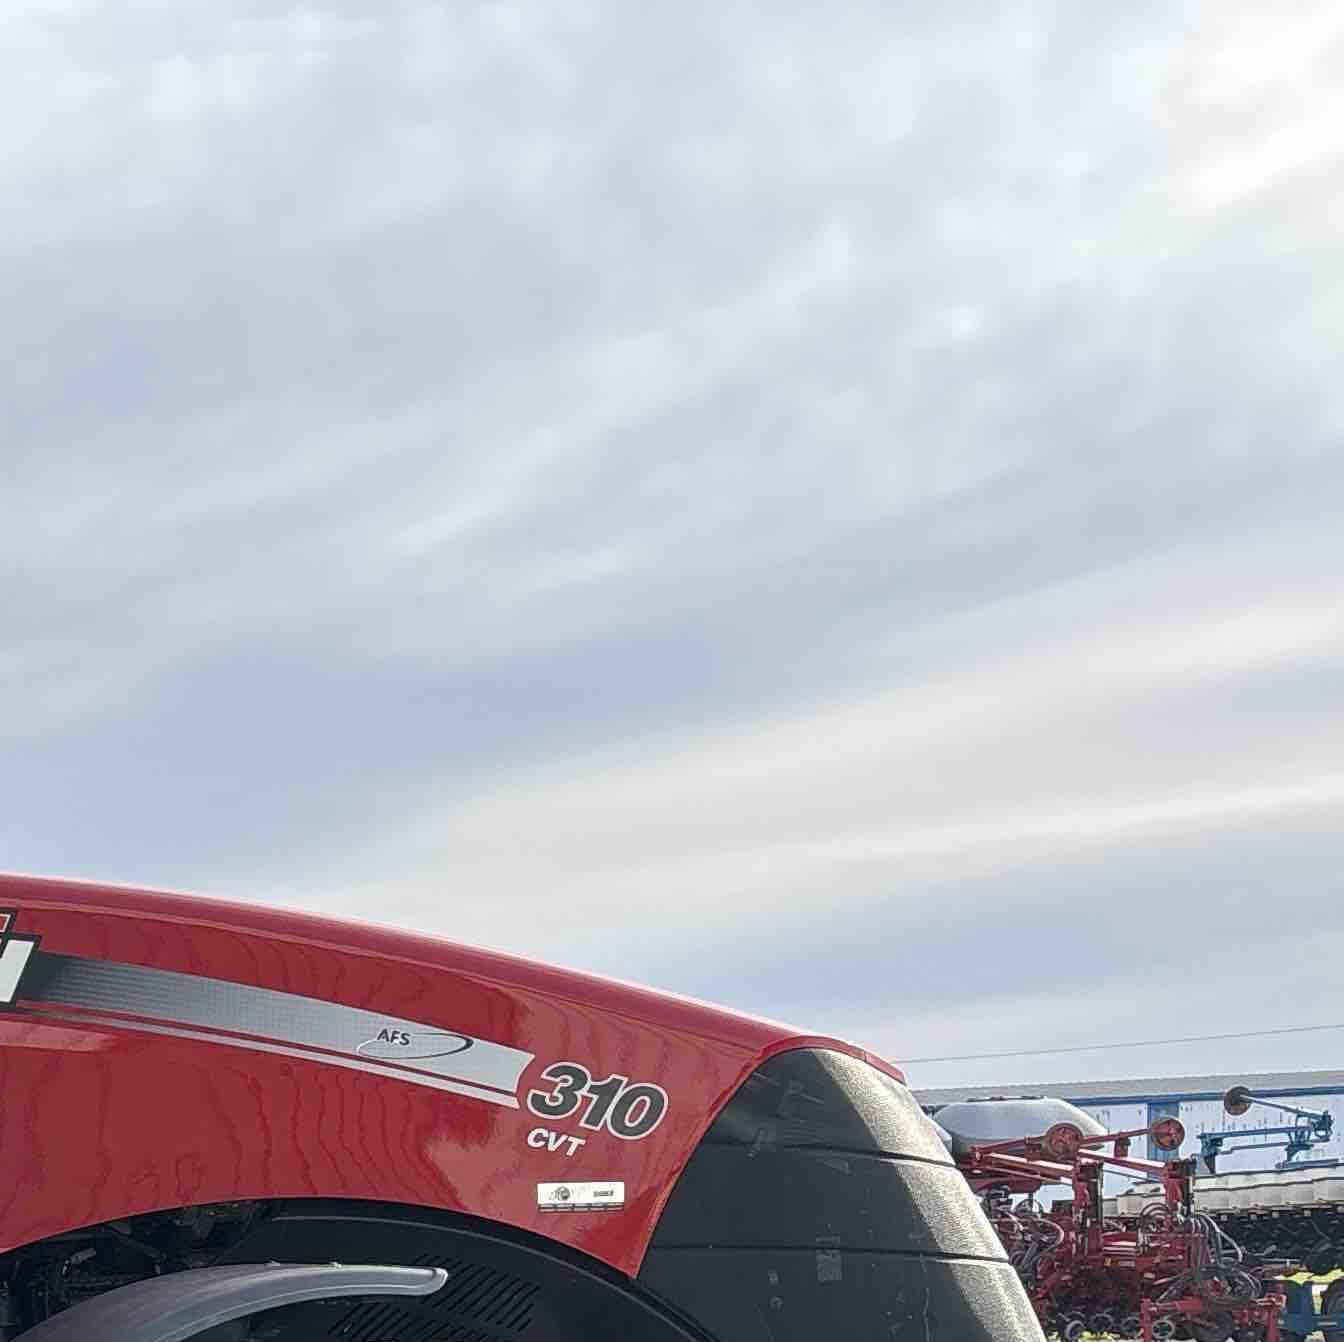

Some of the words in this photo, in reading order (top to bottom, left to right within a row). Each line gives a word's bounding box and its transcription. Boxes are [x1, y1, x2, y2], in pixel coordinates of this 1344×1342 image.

[376, 1028, 411, 1046] AFS
[527, 1061, 669, 1140] 310
[527, 1128, 586, 1156] CVT
